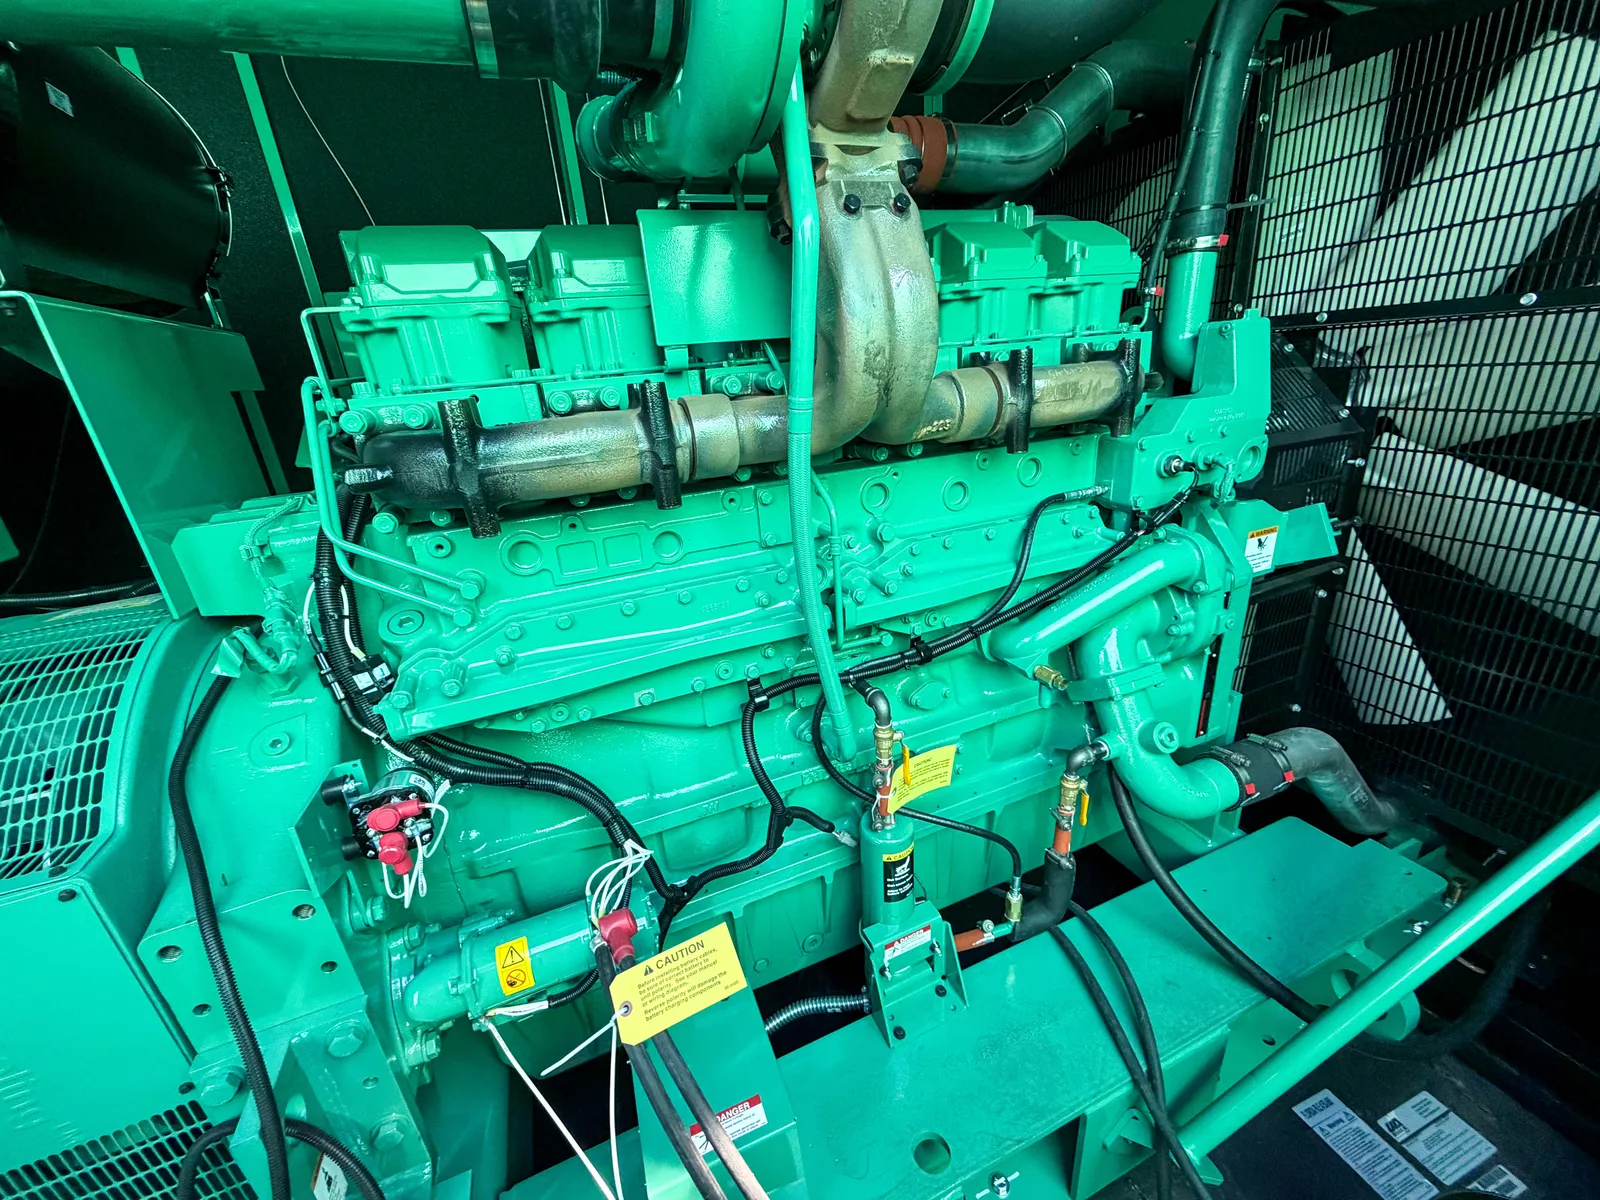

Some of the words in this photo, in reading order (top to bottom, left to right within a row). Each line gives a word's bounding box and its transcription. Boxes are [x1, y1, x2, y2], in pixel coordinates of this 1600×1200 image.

[656, 940, 704, 970] CAUTION
[638, 978, 655, 990] Before
[656, 966, 680, 980] installing
[680, 957, 698, 968] battery
[641, 992, 651, 1001] unit
[652, 983, 673, 996] polarity.
[675, 976, 685, 984] See
[686, 970, 698, 979] your
[699, 959, 718, 972] manual
[646, 983, 658, 991] sure
[665, 970, 684, 982] correct
[684, 961, 702, 972] battery
[644, 1001, 665, 1015] Reverse
[666, 991, 686, 1004] polarity
[687, 985, 696, 993] will
[697, 975, 718, 989] damage
[718, 970, 727, 978] the
[645, 1010, 664, 1021] battery
[665, 996, 688, 1011] charging
[689, 980, 721, 999] components
[649, 993, 665, 1003] wiring
